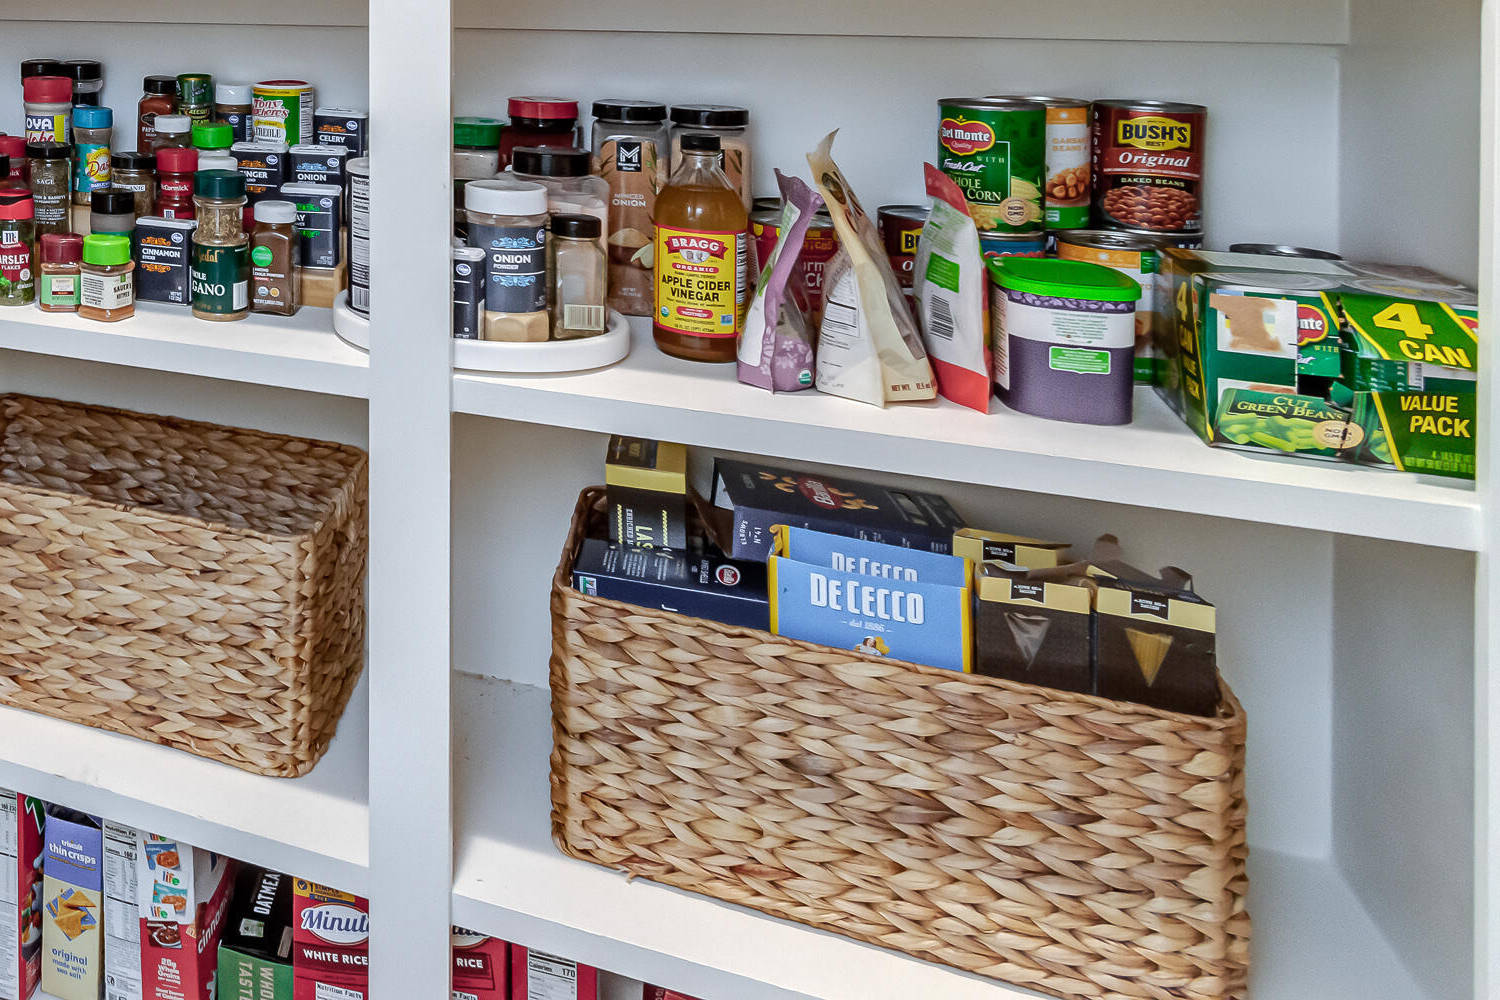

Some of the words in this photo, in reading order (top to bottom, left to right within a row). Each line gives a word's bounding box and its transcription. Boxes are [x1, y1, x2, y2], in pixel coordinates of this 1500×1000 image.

[26, 118, 53, 130] OYA
[318, 134, 346, 143] CELERY
[941, 127, 953, 139] Del
[954, 129, 990, 142] Monte
[1122, 123, 1189, 143] BUSH'S
[943, 158, 964, 170] Fresh
[963, 161, 987, 173] Cut
[976, 156, 1005, 164] WITH
[1118, 151, 1191, 168] Original
[87, 160, 109, 177] Das
[242, 171, 268, 179] INGER
[297, 173, 327, 182] ONION
[950, 175, 981, 188] HOLE
[1155, 179, 1185, 187] BEANS
[966, 188, 1001, 201] CORN
[612, 199, 647, 207] ONION
[671, 238, 720, 252] BRAGG
[141, 248, 181, 258] CINNAMON
[492, 254, 532, 263] ONION
[192, 269, 207, 281] HOLE
[676, 264, 715, 273] ORGANIC
[192, 281, 226, 297] GANO
[661, 274, 693, 289] APPLE
[697, 280, 731, 291] CIDER
[670, 287, 720, 302] VINEGAR
[1298, 317, 1323, 331] nte
[1372, 301, 1434, 340] 4
[1313, 344, 1339, 353] WITH
[1398, 338, 1473, 368] CAN
[1272, 395, 1318, 409] CUT
[1399, 394, 1459, 413] VALUE
[1236, 400, 1290, 415] GREEN
[1291, 406, 1347, 421] BEANS
[1410, 414, 1471, 438] PACK
[809, 572, 843, 611] DE
[846, 579, 925, 625] CECCO
[848, 619, 862, 629] dal
[864, 621, 886, 633] 1886
[49, 843, 68, 858] thin
[67, 851, 97, 866] crisps
[162, 870, 181, 886] life
[253, 871, 282, 916] OATMEA
[150, 905, 169, 919] life
[197, 896, 228, 955] cinnamon
[303, 908, 369, 934] Minut
[51, 947, 88, 967] original
[303, 948, 339, 964] WHITE
[342, 952, 369, 967] RICE
[456, 957, 484, 970] RICE
[52, 957, 70, 970] made
[70, 963, 87, 975] with
[561, 968, 576, 978] 170
[69, 970, 82, 980] salt
[316, 982, 343, 996] Nutrition
[344, 988, 363, 1000] Facts
